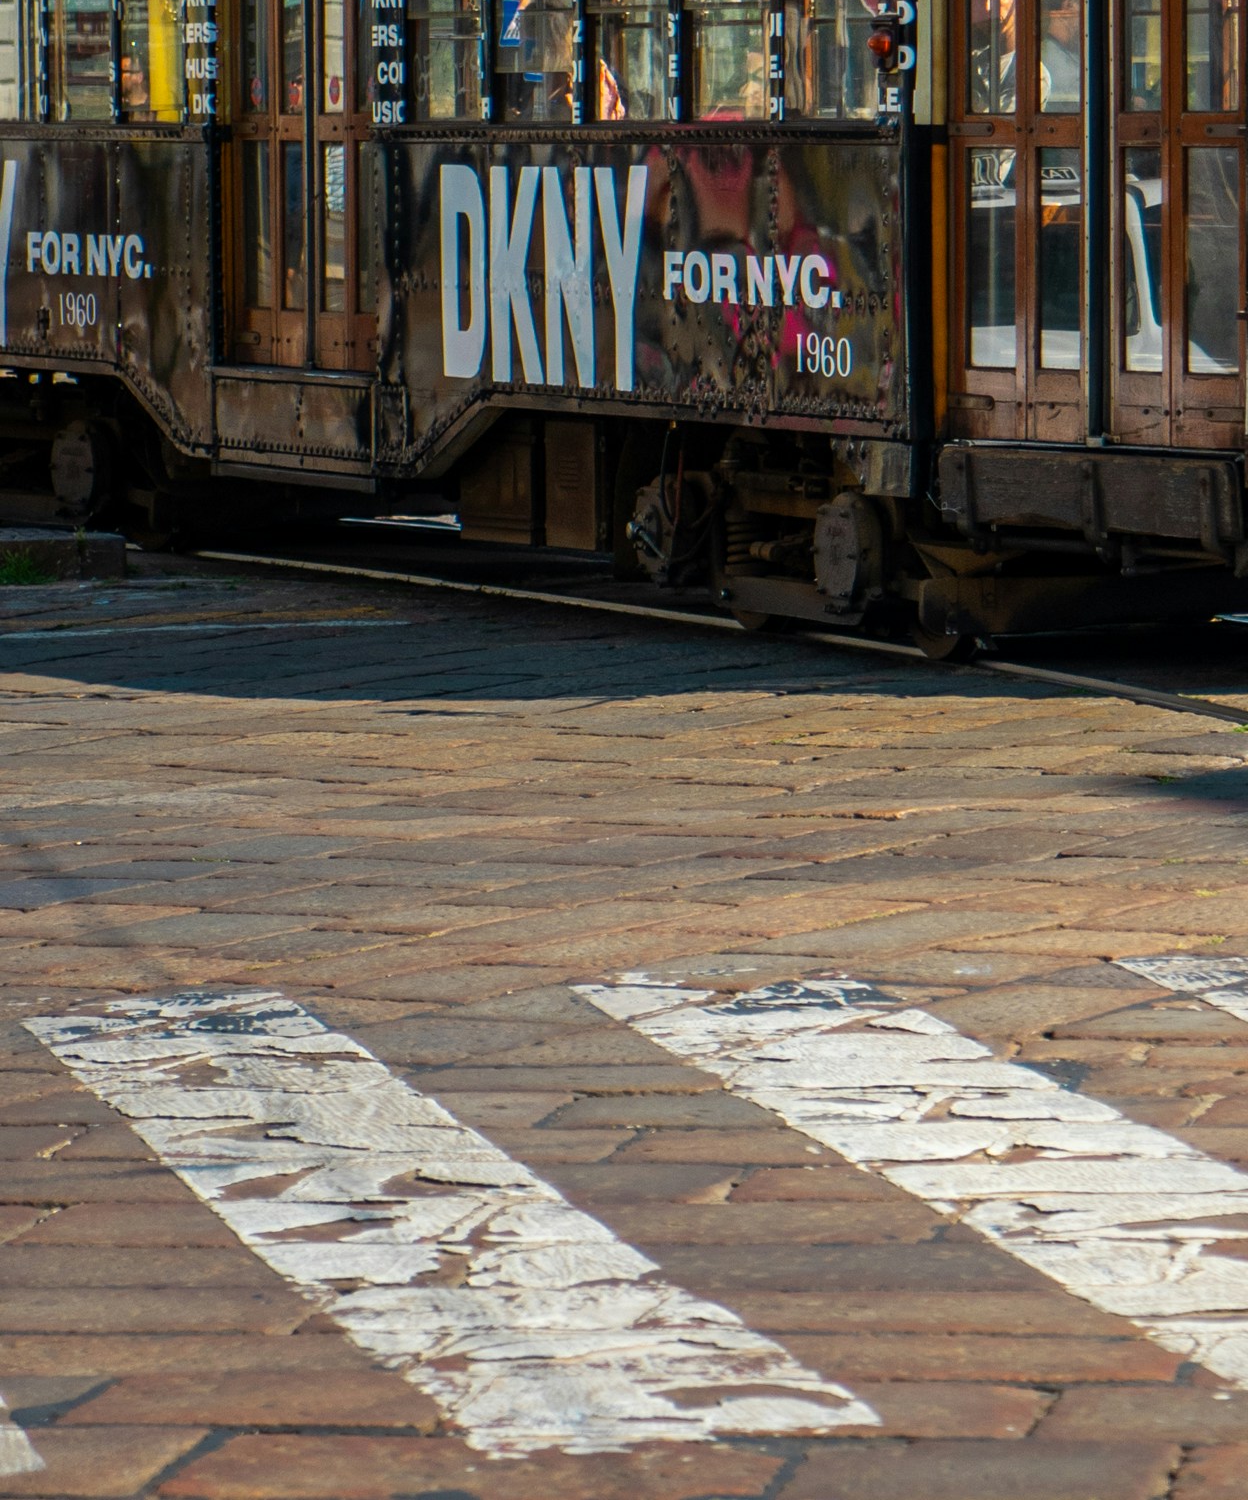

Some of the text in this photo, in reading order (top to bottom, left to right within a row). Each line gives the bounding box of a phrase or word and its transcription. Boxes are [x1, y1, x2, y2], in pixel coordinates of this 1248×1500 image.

[27, 231, 152, 279] FOR NYC.
[440, 164, 647, 392] DKNY
[663, 250, 842, 309] FOR NYC.
[58, 291, 97, 327] 1960
[796, 332, 852, 378] 1960
